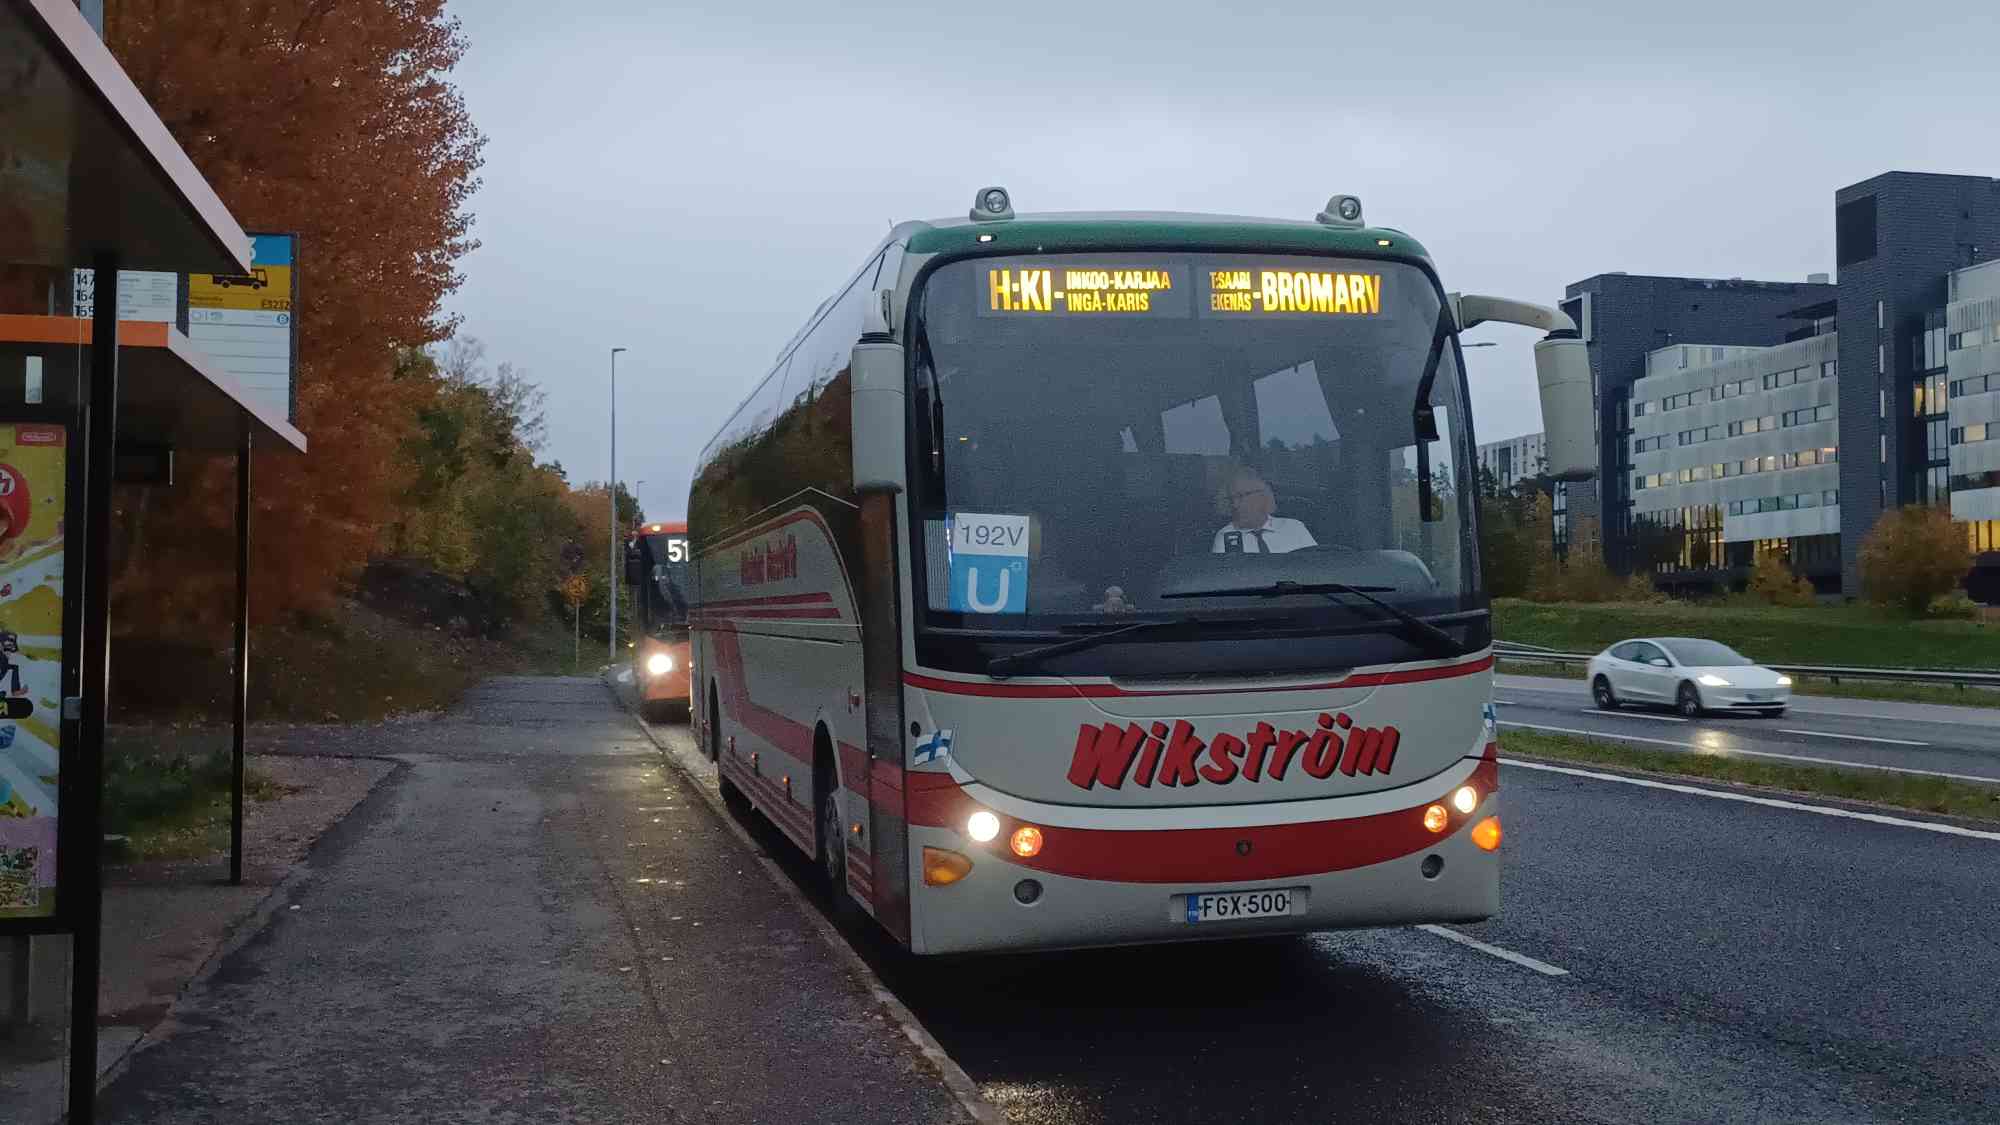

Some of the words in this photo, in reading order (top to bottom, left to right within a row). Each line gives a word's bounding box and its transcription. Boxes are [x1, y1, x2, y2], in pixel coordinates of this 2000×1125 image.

[1066, 271, 1171, 290] INKOO-KARJAA
[1067, 291, 1149, 311] INGÅ-KARIS
[1210, 292, 1253, 311] EKENÄS
[961, 525, 1024, 546] 192V
[967, 567, 1010, 613] U
[1066, 711, 1400, 791] Wikström
[1203, 893, 1286, 918] FGX-500
